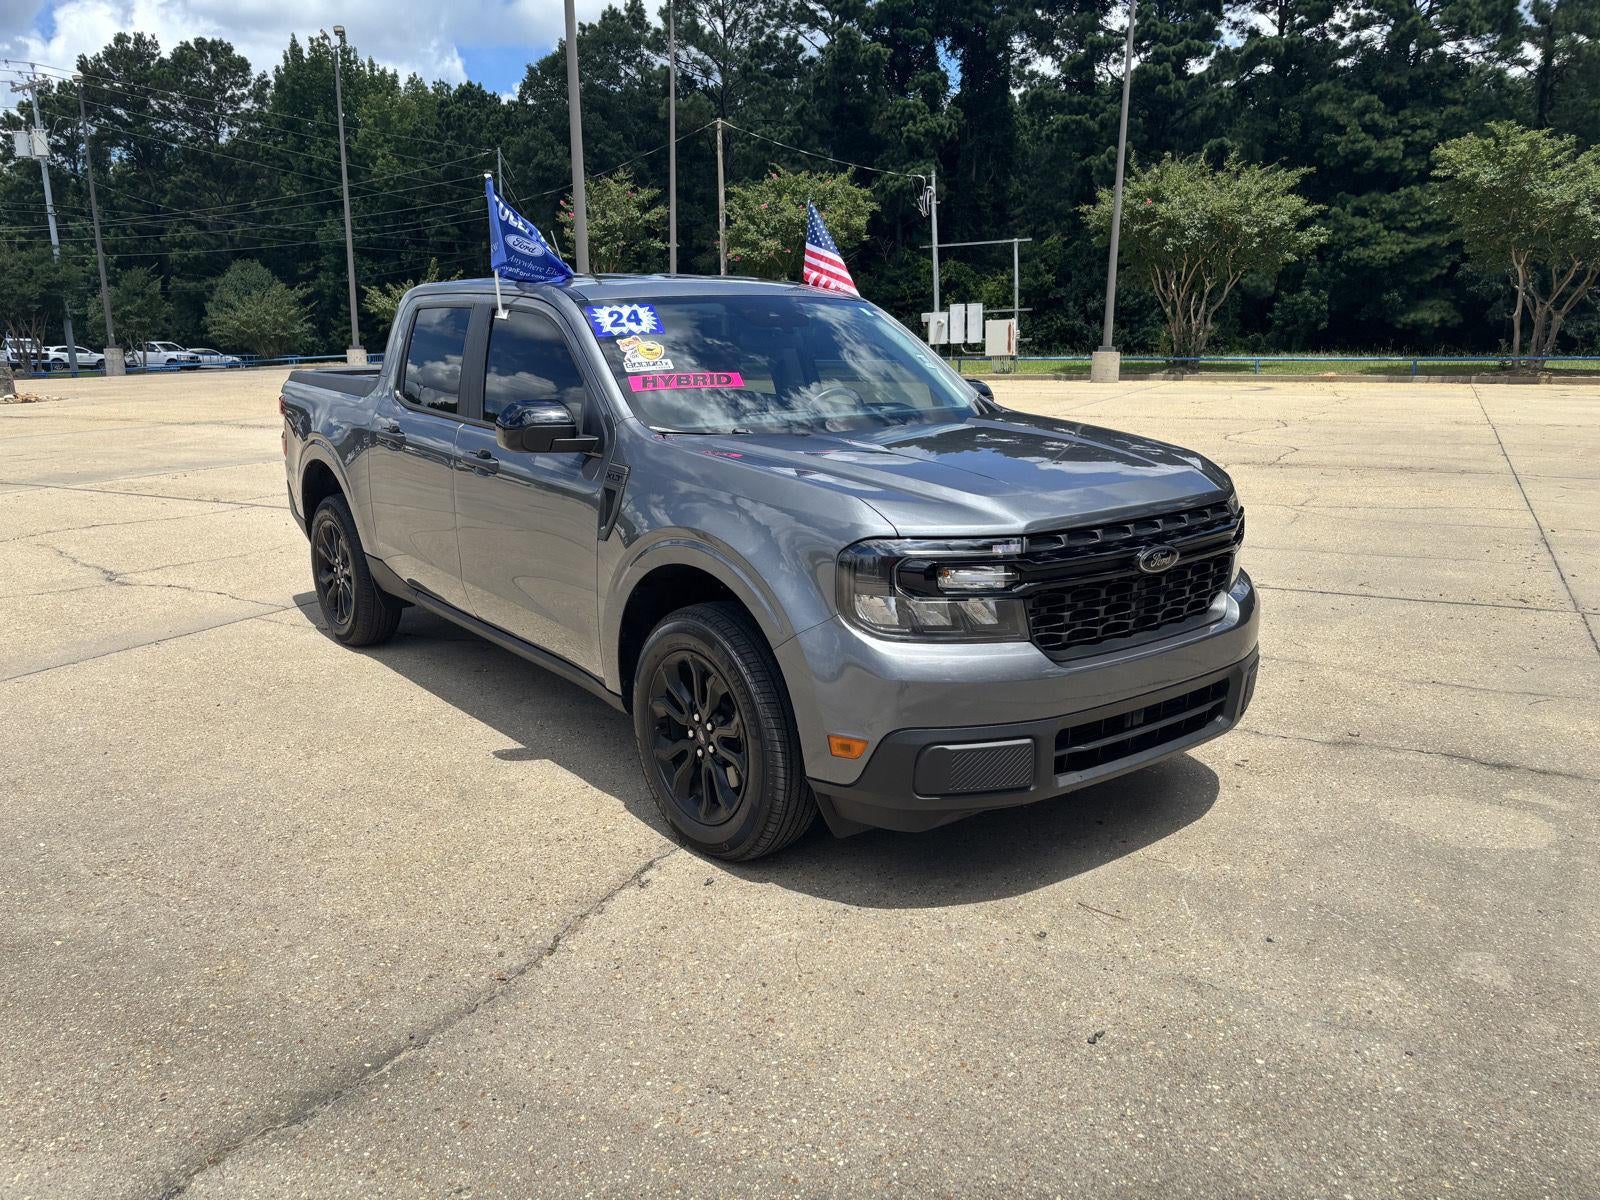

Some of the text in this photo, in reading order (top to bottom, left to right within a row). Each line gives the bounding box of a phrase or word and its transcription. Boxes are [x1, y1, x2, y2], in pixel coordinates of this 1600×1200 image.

[512, 237, 536, 254] Ford
[507, 254, 545, 273] Anywhere
[608, 309, 643, 328] 24
[625, 360, 670, 369] CARFAX
[641, 374, 732, 388] HYBRID
[606, 471, 623, 481] XLT
[1151, 551, 1171, 567] Ford
